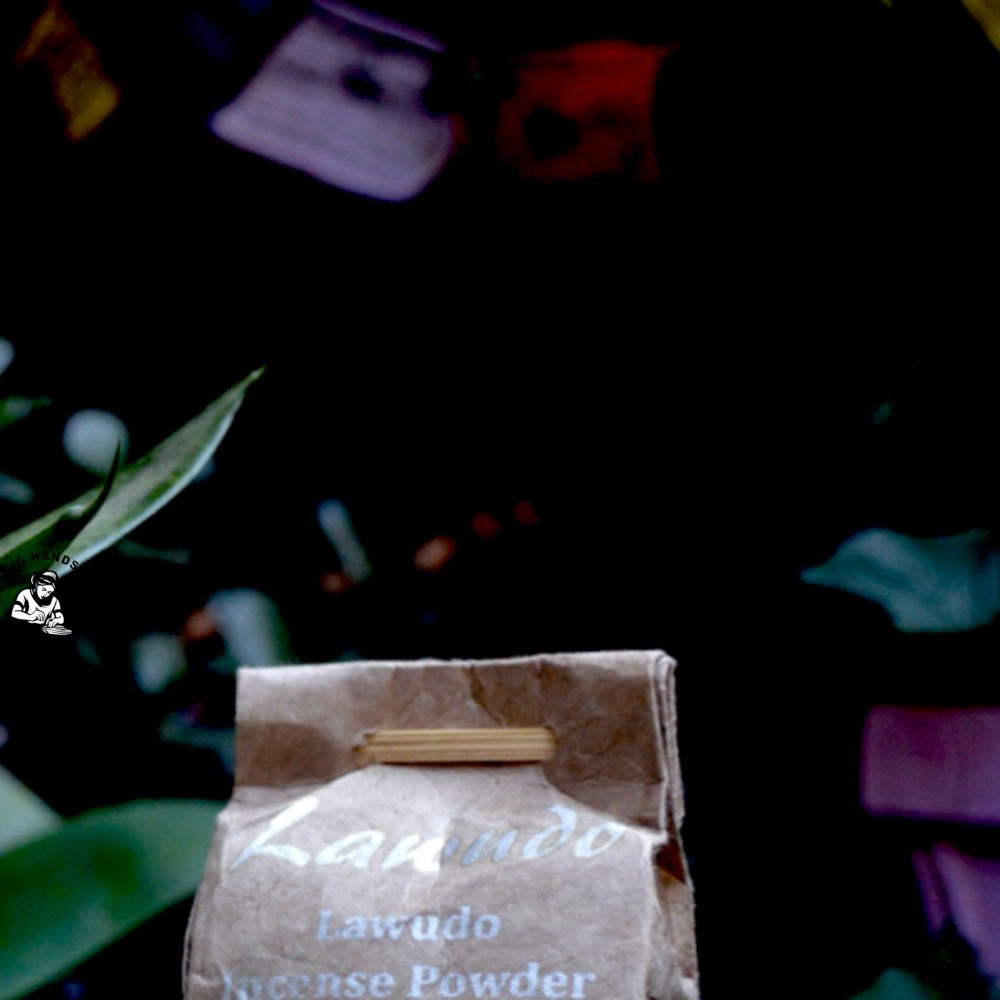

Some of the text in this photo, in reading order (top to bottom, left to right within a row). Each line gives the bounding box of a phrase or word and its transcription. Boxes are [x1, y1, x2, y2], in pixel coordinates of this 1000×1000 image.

[229, 796, 628, 873] Lawudo
[315, 906, 501, 941] Lawudo
[406, 962, 597, 999] Powder
